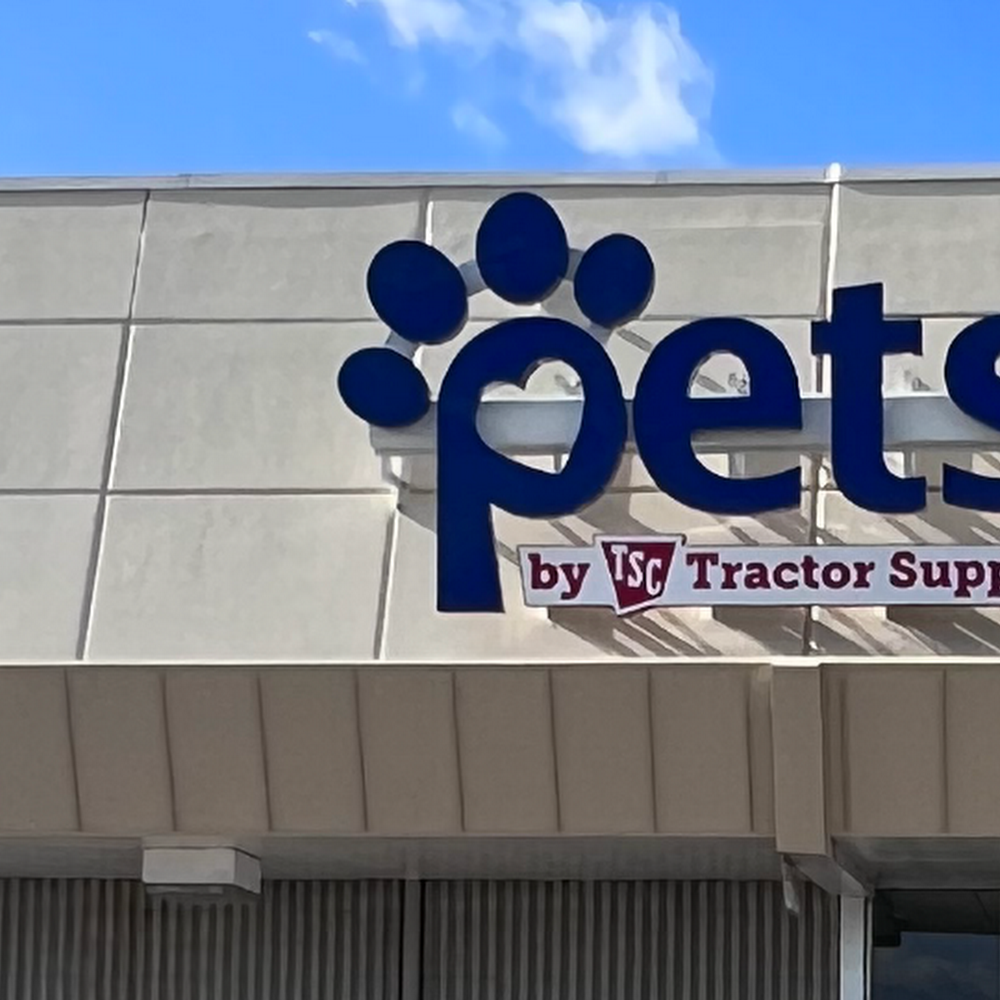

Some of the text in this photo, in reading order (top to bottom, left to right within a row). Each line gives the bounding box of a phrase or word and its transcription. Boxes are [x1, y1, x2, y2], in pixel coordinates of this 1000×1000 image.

[528, 553, 590, 600] by
[610, 544, 662, 596] TSC
[686, 552, 875, 590] Tractor
